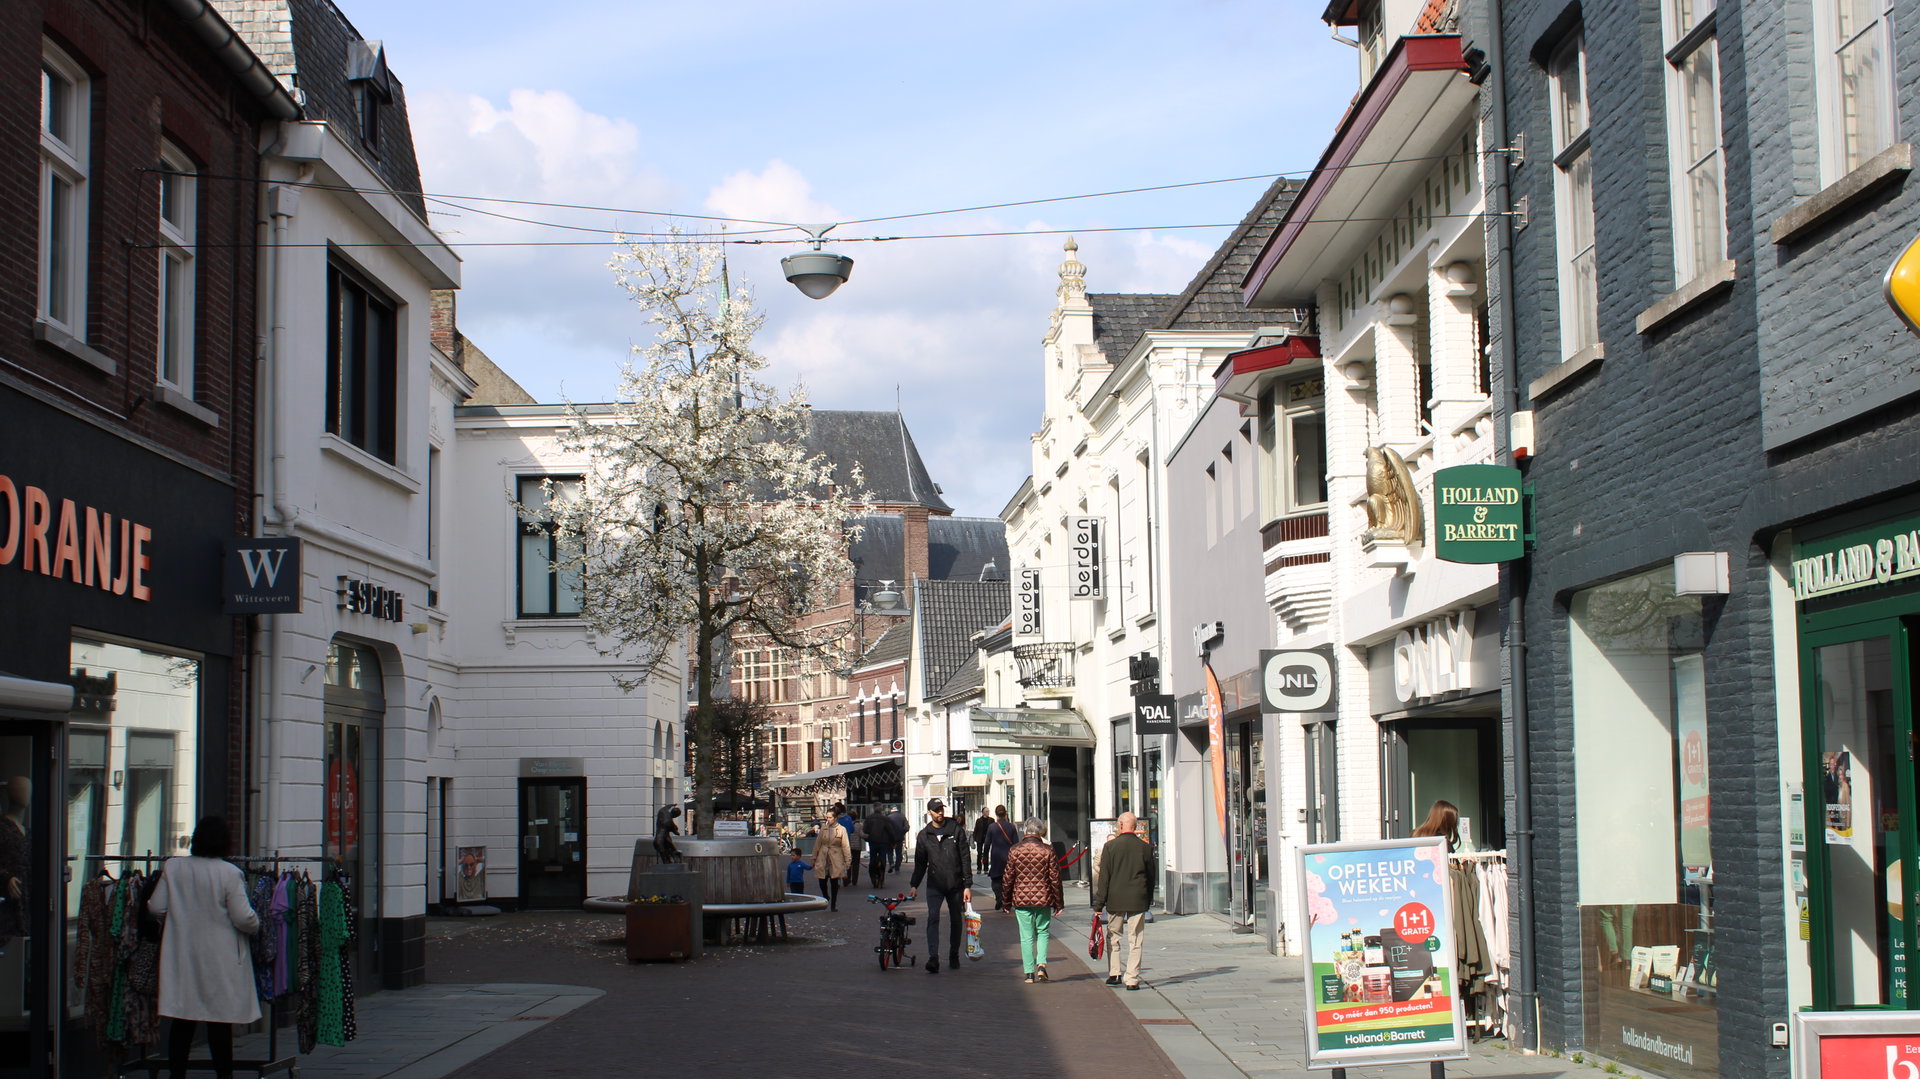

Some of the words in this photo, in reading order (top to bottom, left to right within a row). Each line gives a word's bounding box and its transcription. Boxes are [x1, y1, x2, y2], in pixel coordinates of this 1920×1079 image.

[1441, 487, 1519, 505] HOLLAND
[1473, 505, 1488, 523] &
[0, 474, 151, 602] ORANJE
[1444, 524, 1518, 541] BARRETT
[237, 548, 288, 588] W
[1073, 519, 1091, 597] berden
[1792, 543, 1874, 601] HOLLAND
[1876, 538, 1893, 584] &
[1894, 530, 1920, 573] BA
[234, 594, 291, 603] Witteveen
[336, 575, 405, 623] ESPRIT
[1018, 570, 1033, 634] berden
[1394, 610, 1477, 702] ONLY
[1269, 673, 1328, 689] ONLY
[1328, 860, 1416, 880] OPFLEUR
[1338, 876, 1408, 896] WEKEN
[1400, 909, 1428, 928] 1+1
[1332, 1012, 1345, 1022] Op
[1364, 1009, 1378, 1017] dan
[1379, 1006, 1394, 1014] 950
[1395, 1001, 1434, 1015] producten!
[1622, 1025, 1693, 1065] hollandandbarrett.nl
[1905, 1045, 1920, 1054] Ee
